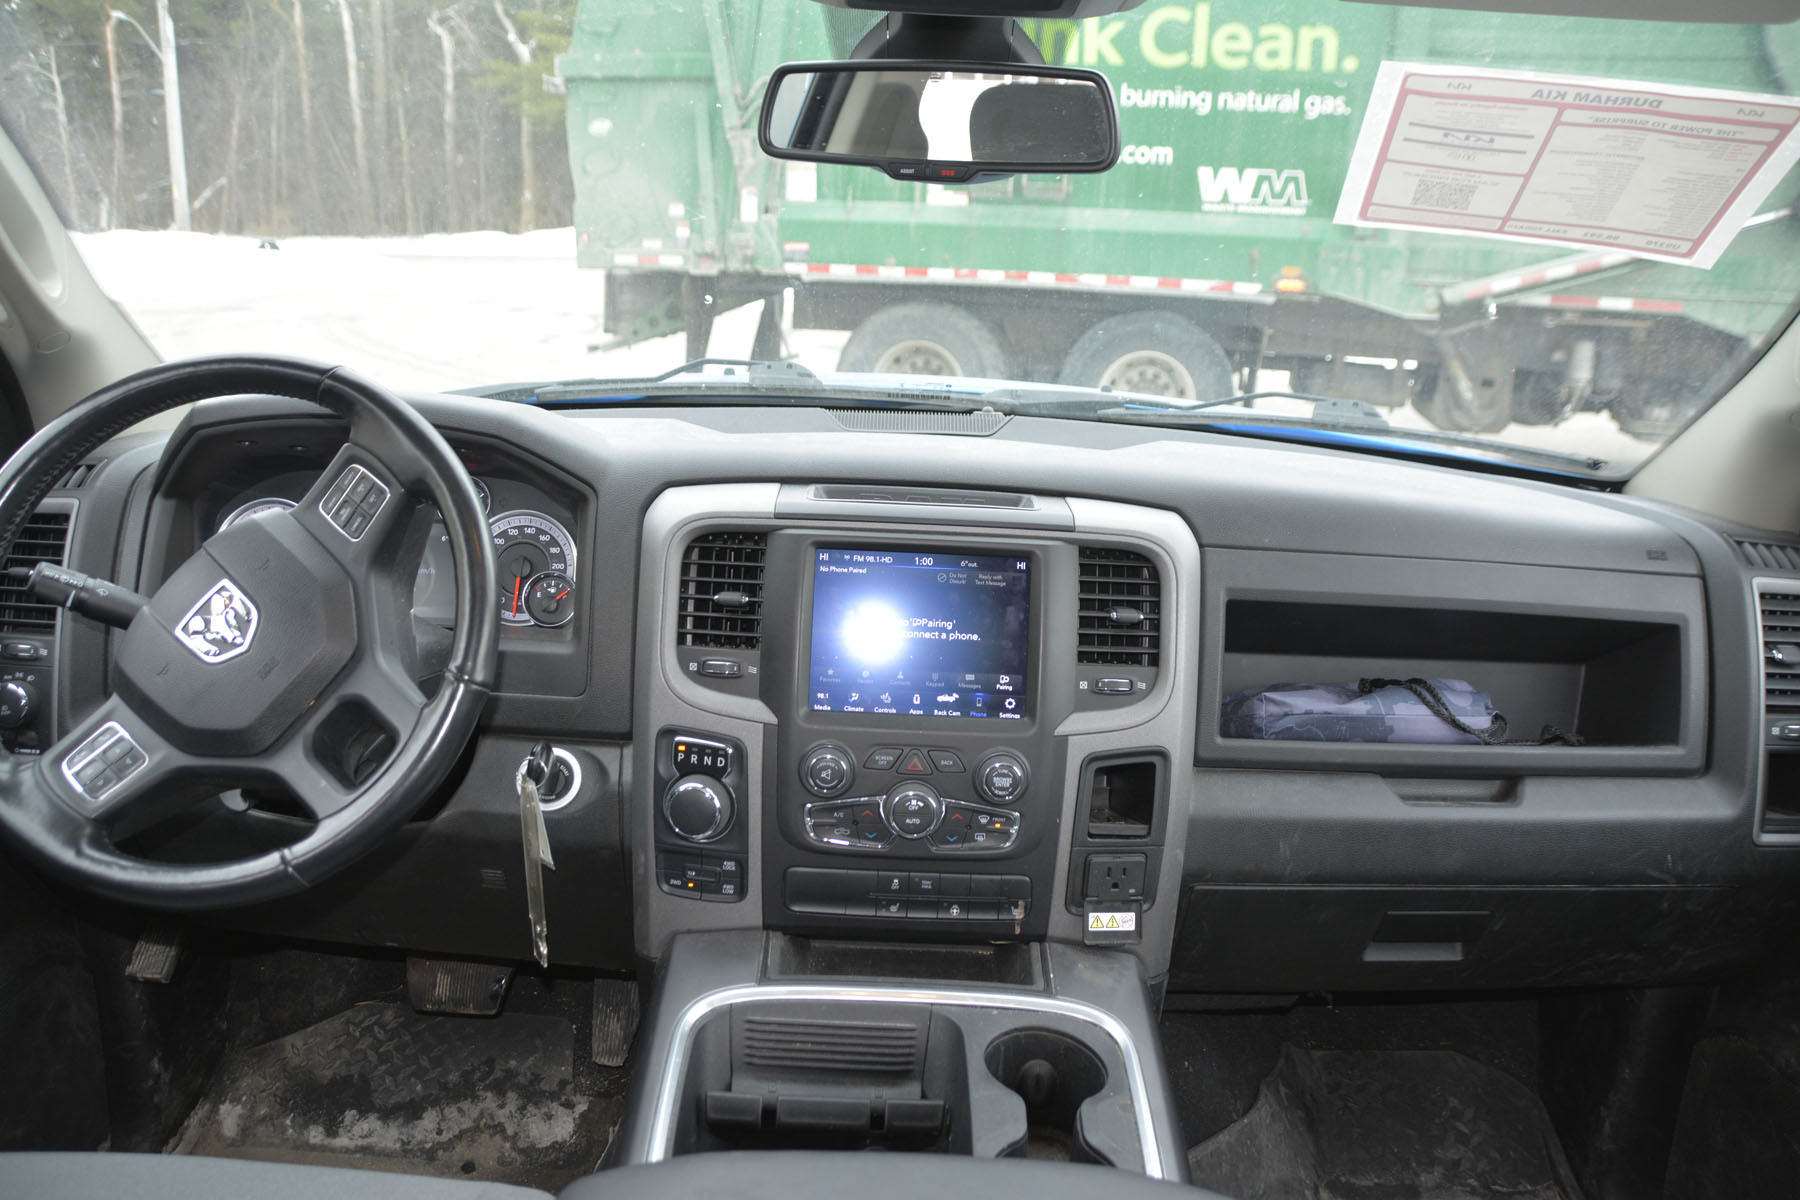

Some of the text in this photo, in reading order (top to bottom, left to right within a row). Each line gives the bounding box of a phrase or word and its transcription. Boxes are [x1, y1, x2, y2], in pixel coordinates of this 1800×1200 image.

[1139, 2, 1359, 72] Clean.
[1120, 83, 1351, 120] burning natural gas.
[1197, 165, 1309, 206] WM
[508, 528, 519, 536] 120
[524, 527, 535, 535] 140
[494, 537, 505, 545] 100
[539, 534, 551, 542] 160
[549, 546, 560, 554] 180
[819, 552, 829, 561] HI
[853, 554, 865, 562] FM
[914, 556, 934, 567] 1:00
[1016, 561, 1026, 570] HI
[551, 562, 565, 570] 200
[829, 565, 848, 573] Phone
[848, 566, 867, 574] Paired
[941, 632, 947, 640] a
[949, 630, 982, 642] phone.
[996, 684, 1013, 692] Pairing
[874, 706, 897, 714] Controls
[909, 708, 924, 716] Apps
[999, 712, 1021, 720] Settings
[677, 752, 726, 768] P R N D
